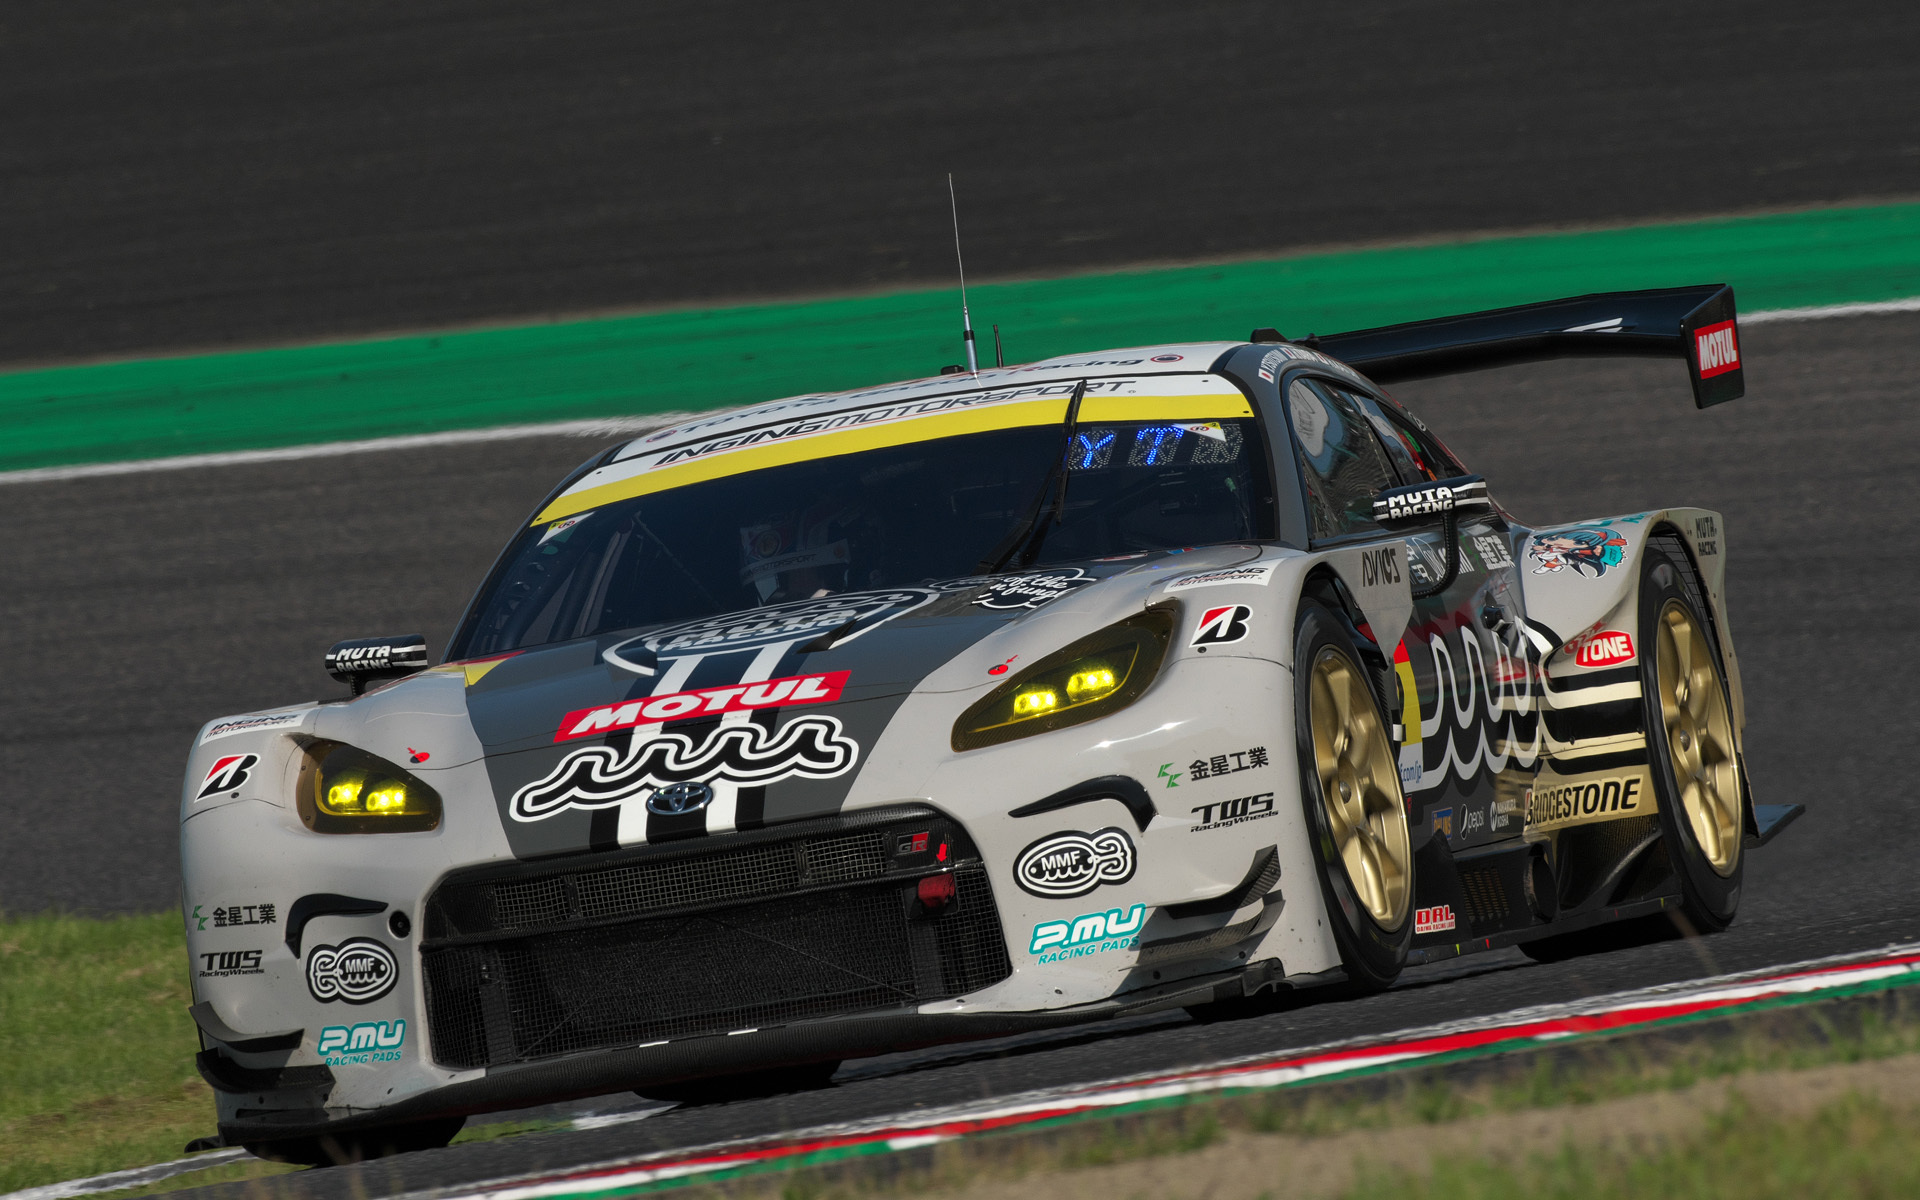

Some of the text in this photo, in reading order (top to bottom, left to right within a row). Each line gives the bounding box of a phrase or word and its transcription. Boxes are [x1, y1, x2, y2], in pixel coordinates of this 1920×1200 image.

[1698, 327, 1738, 371] MOTUL
[1388, 486, 1453, 507] MUTA
[1390, 499, 1453, 519] RACING
[335, 645, 392, 661] MUTA
[1581, 635, 1632, 663] TONE
[336, 658, 392, 673] RACING
[567, 676, 831, 735] MOTUL
[1188, 746, 1270, 781] 金星工業
[1190, 792, 1275, 825] TWS
[1525, 778, 1641, 825] BRIDGESTONE
[899, 839, 926, 853] GR
[1041, 850, 1082, 871] MMF
[212, 903, 277, 928] 金星工業
[1416, 906, 1455, 925] DRL
[199, 949, 263, 971] TWS
[1038, 935, 1141, 966] RACING PADS
[344, 957, 376, 974] MMF
[324, 1051, 403, 1067] RACING PADS
